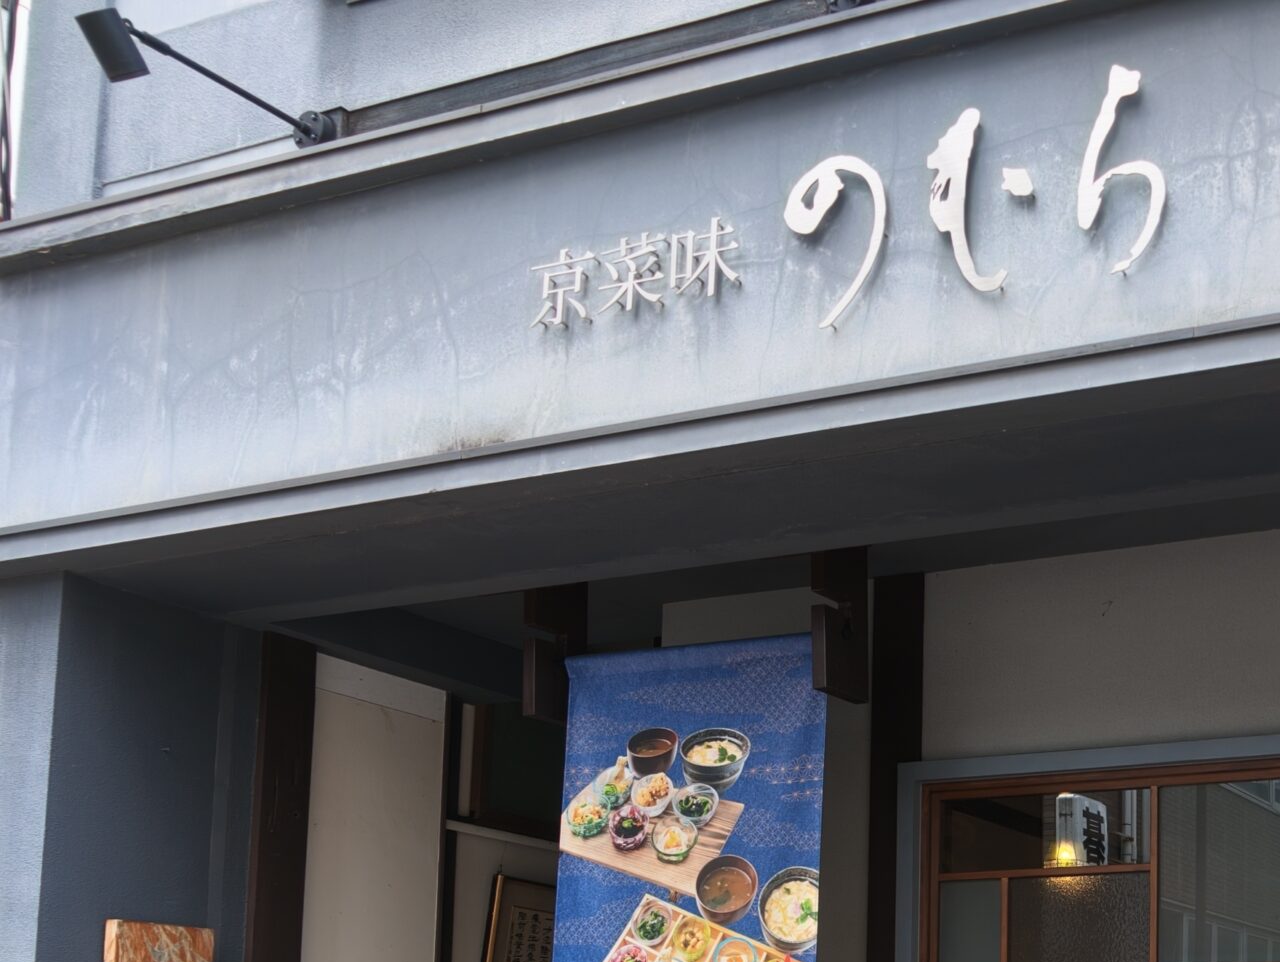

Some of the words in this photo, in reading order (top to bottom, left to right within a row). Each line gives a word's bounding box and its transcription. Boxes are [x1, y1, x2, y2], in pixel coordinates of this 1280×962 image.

[531, 216, 740, 329] 京菜味
[783, 64, 1166, 329] のむら
